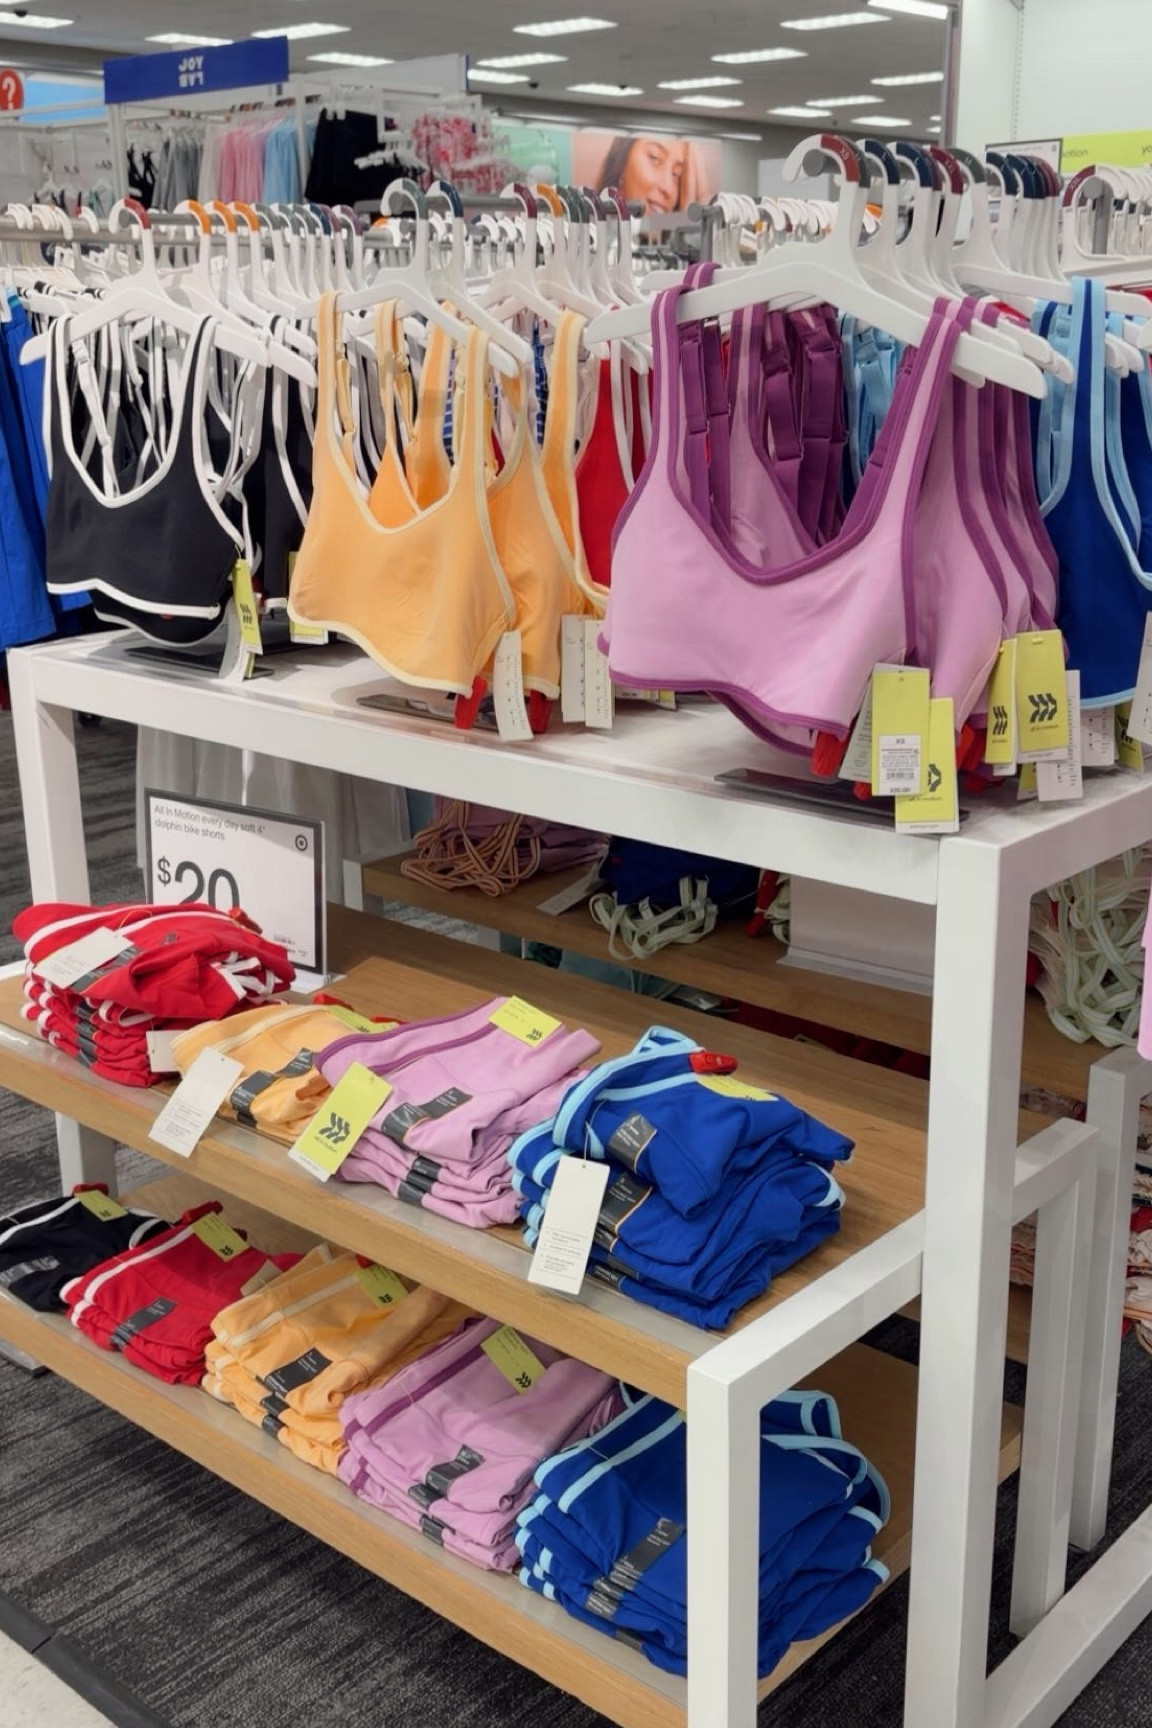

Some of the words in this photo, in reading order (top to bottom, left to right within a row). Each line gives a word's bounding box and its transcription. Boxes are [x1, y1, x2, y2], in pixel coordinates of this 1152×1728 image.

[178, 55, 203, 72] JOY
[154, 804, 164, 814] All
[174, 808, 200, 821] Motion
[201, 815, 222, 828] every
[224, 819, 239, 832] day
[154, 820, 183, 832] dolphin
[184, 824, 200, 835] bike
[201, 827, 225, 840] shorts
[157, 856, 240, 912] $20
